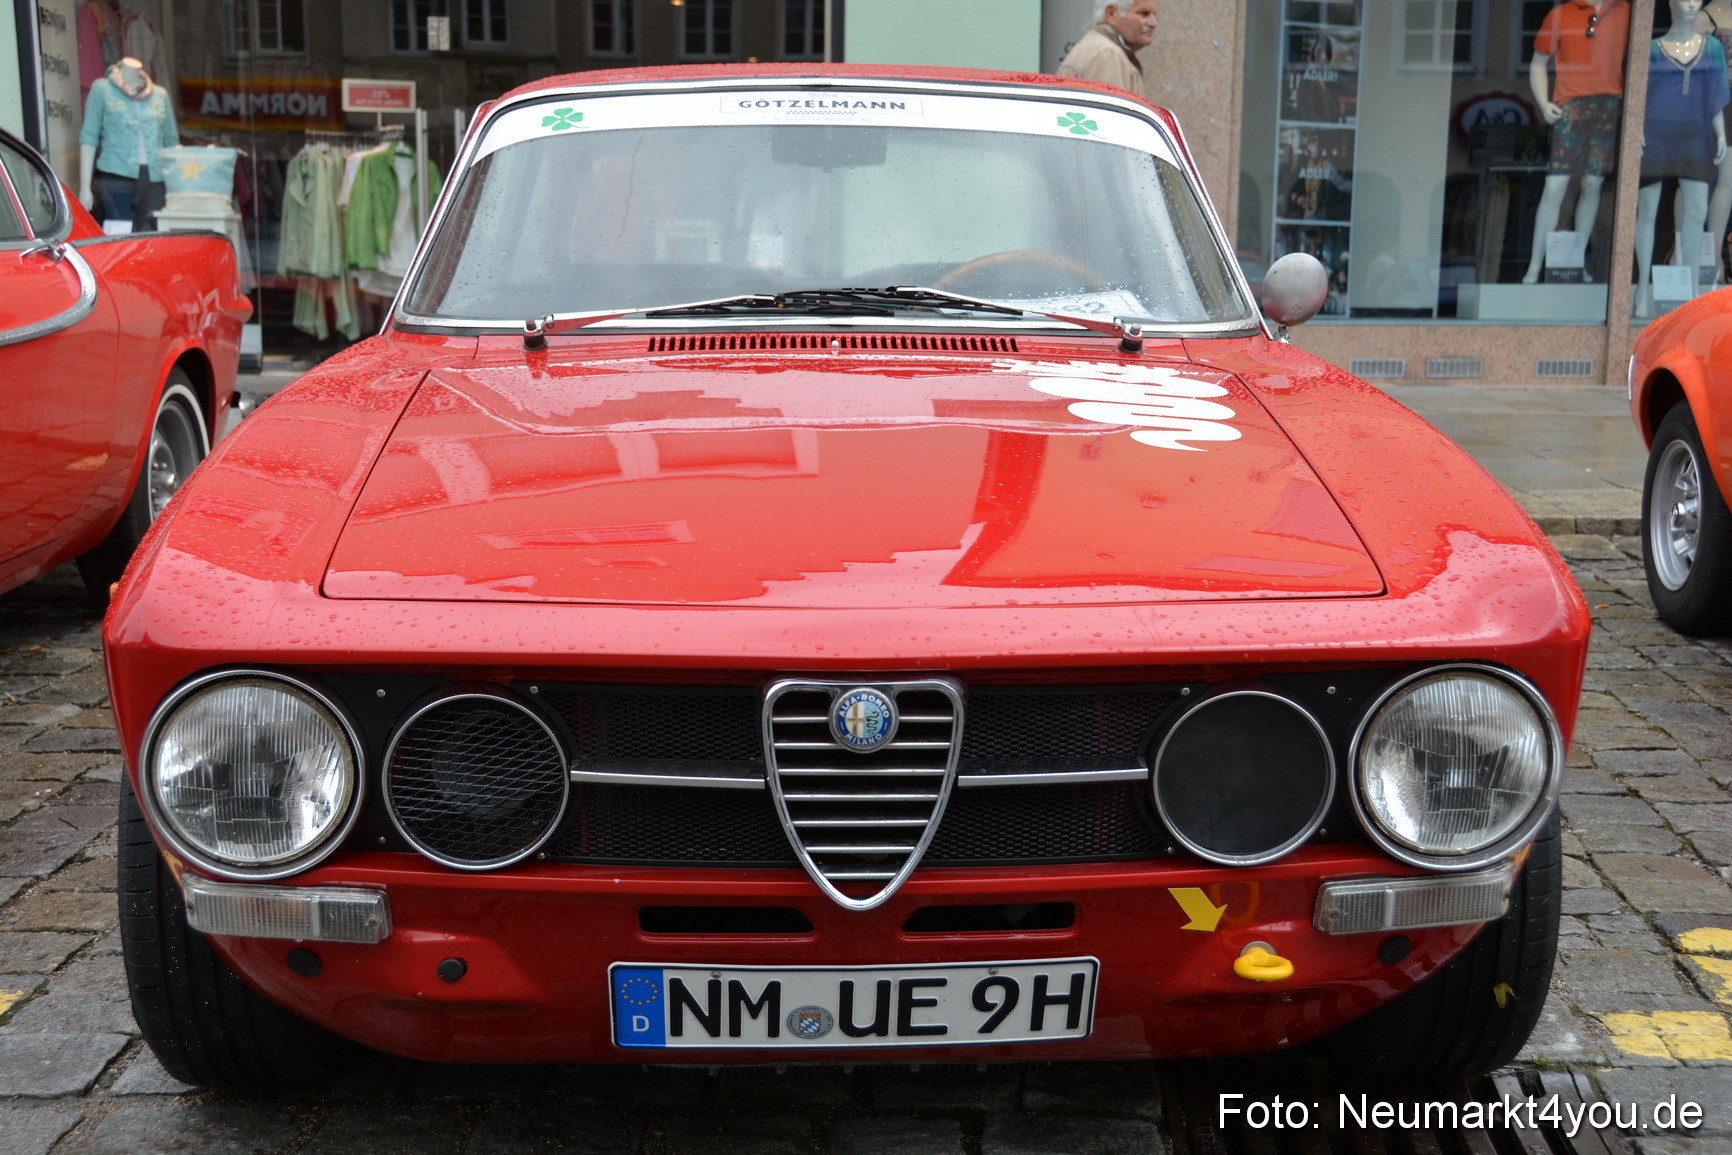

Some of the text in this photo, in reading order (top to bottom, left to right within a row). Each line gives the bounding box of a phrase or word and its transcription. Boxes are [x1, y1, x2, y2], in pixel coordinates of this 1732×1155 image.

[738, 98, 906, 110] GÖTZELMANN
[839, 694, 890, 718] ALFA-ROMEO
[845, 733, 882, 745] MILANO
[669, 973, 1086, 1038] NM UE 9H
[632, 1016, 650, 1032] D
